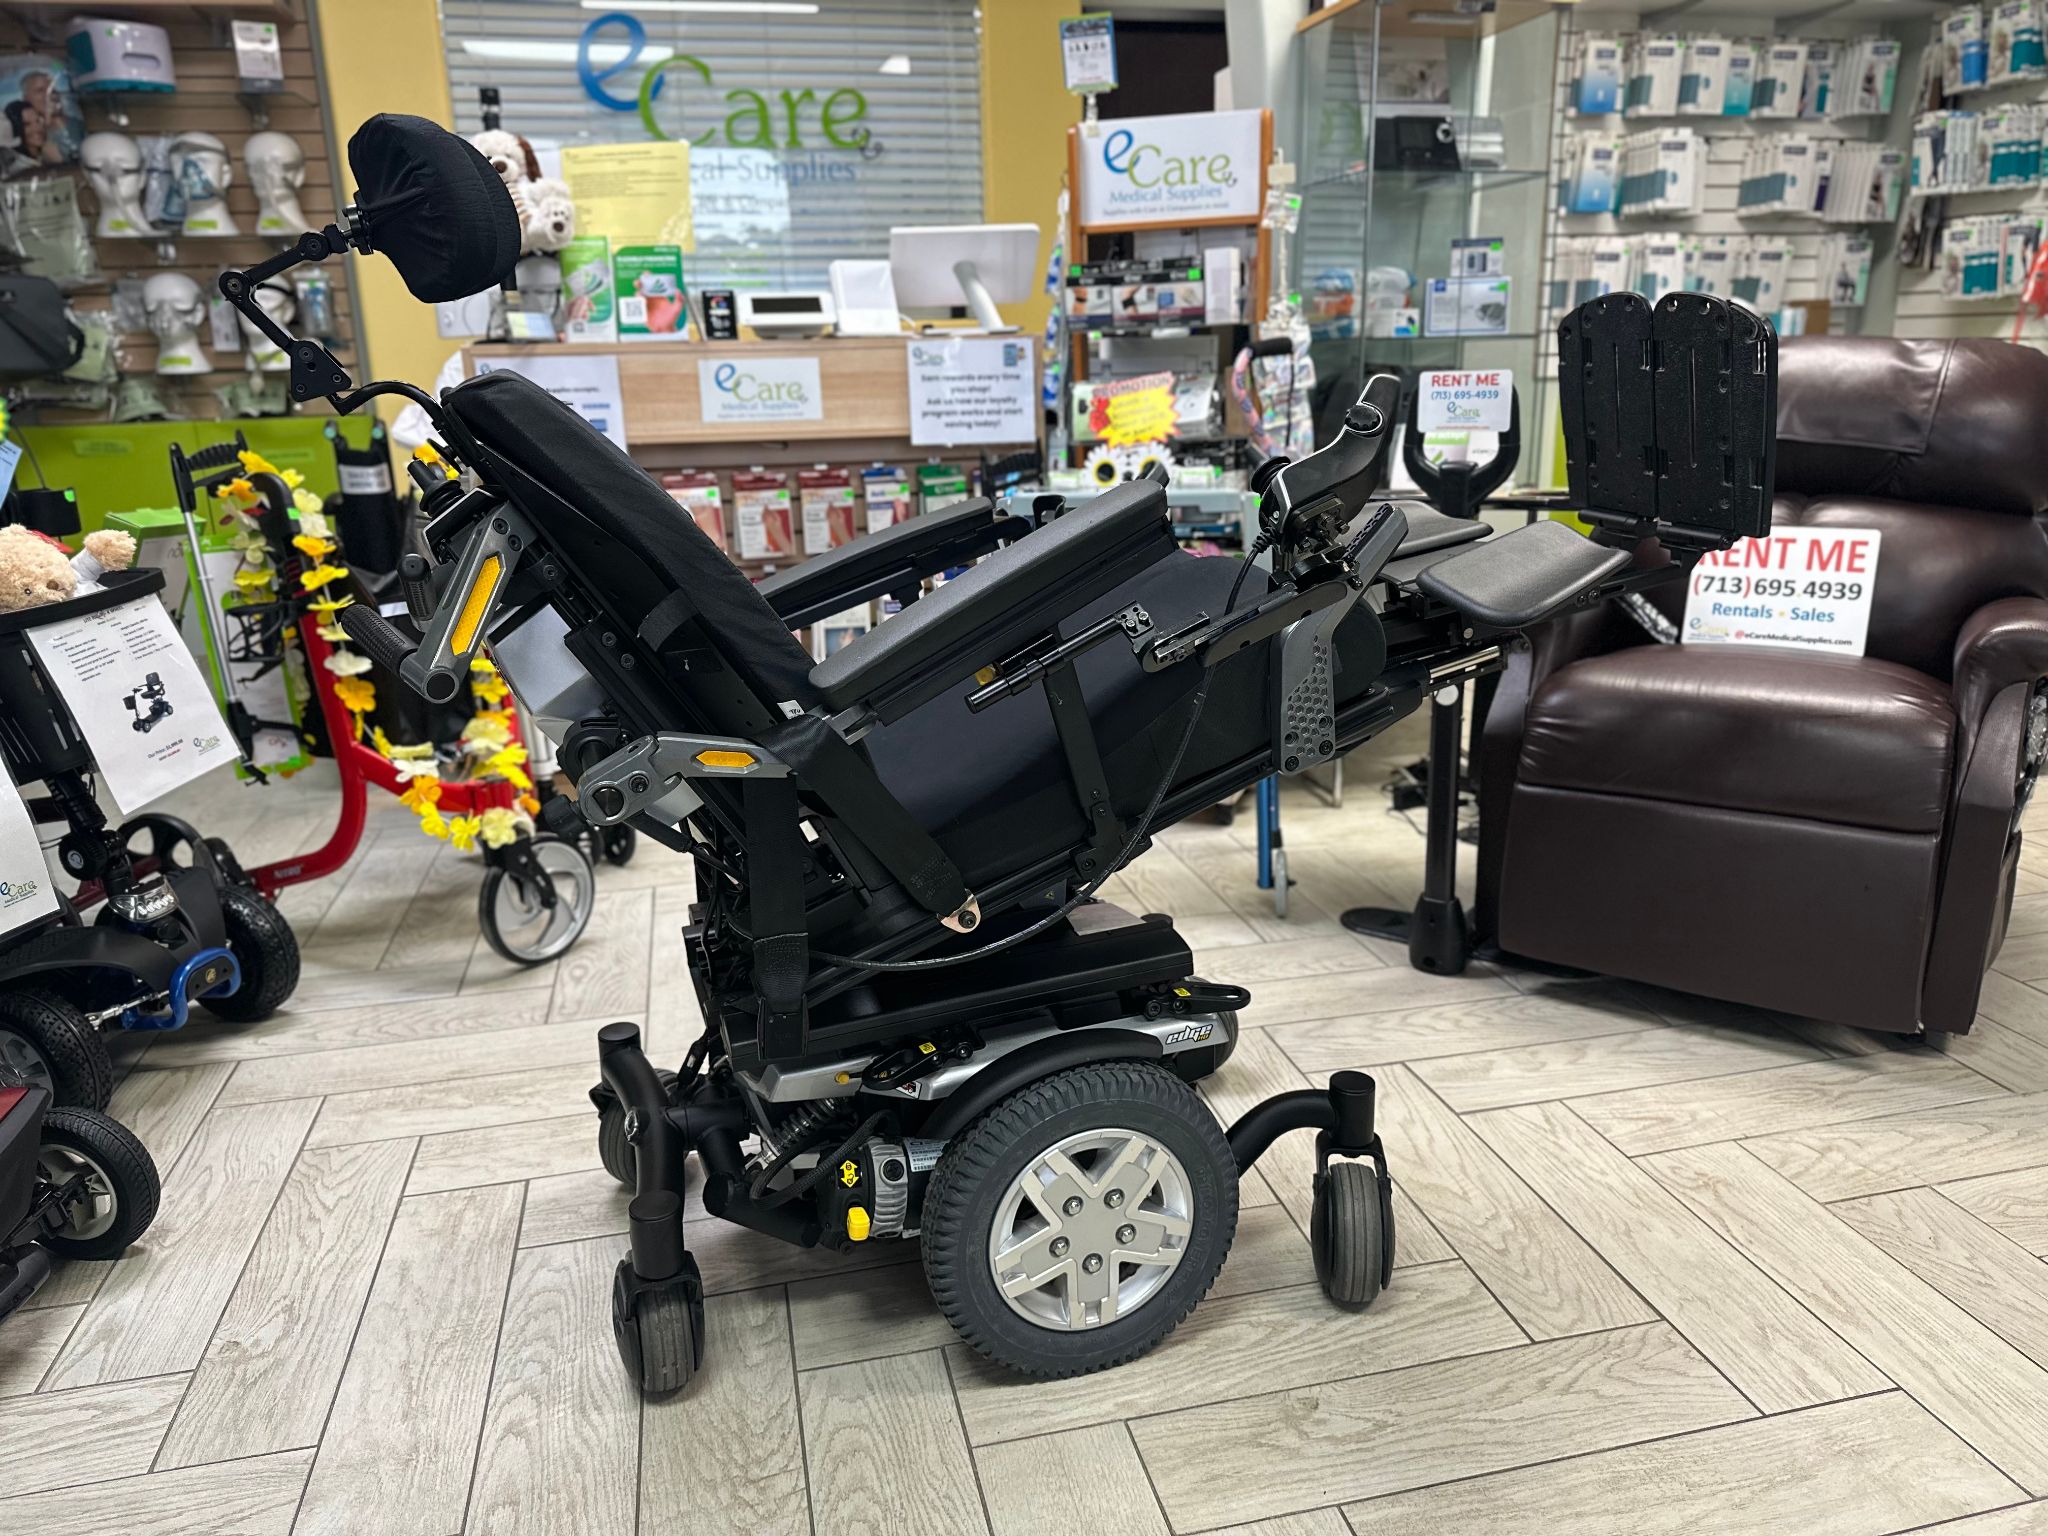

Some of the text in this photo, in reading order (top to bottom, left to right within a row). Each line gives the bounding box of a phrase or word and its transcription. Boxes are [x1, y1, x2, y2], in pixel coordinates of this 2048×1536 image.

[577, 12, 868, 148] eCare
[1103, 129, 1231, 188] eCare
[736, 154, 857, 187] Supplies
[1109, 184, 1223, 205] Medical Supplies
[715, 362, 803, 403] eCare
[941, 374, 976, 382] rewards
[977, 374, 1000, 384] every
[1002, 373, 1021, 381] time
[1431, 373, 1501, 387] RENT ME
[950, 387, 966, 395] you
[1431, 390, 1500, 401] (713) 695-4939
[989, 397, 1017, 405] loyalty
[922, 409, 958, 419] program
[974, 419, 1001, 428] today!
[1806, 539, 1870, 573] ME
[1711, 602, 1836, 623] Rentals Sales
[1734, 630, 1853, 646] @eCareMedicalSupplies.com
[0, 880, 35, 897] eCare
[1165, 1023, 1214, 1046] edge
